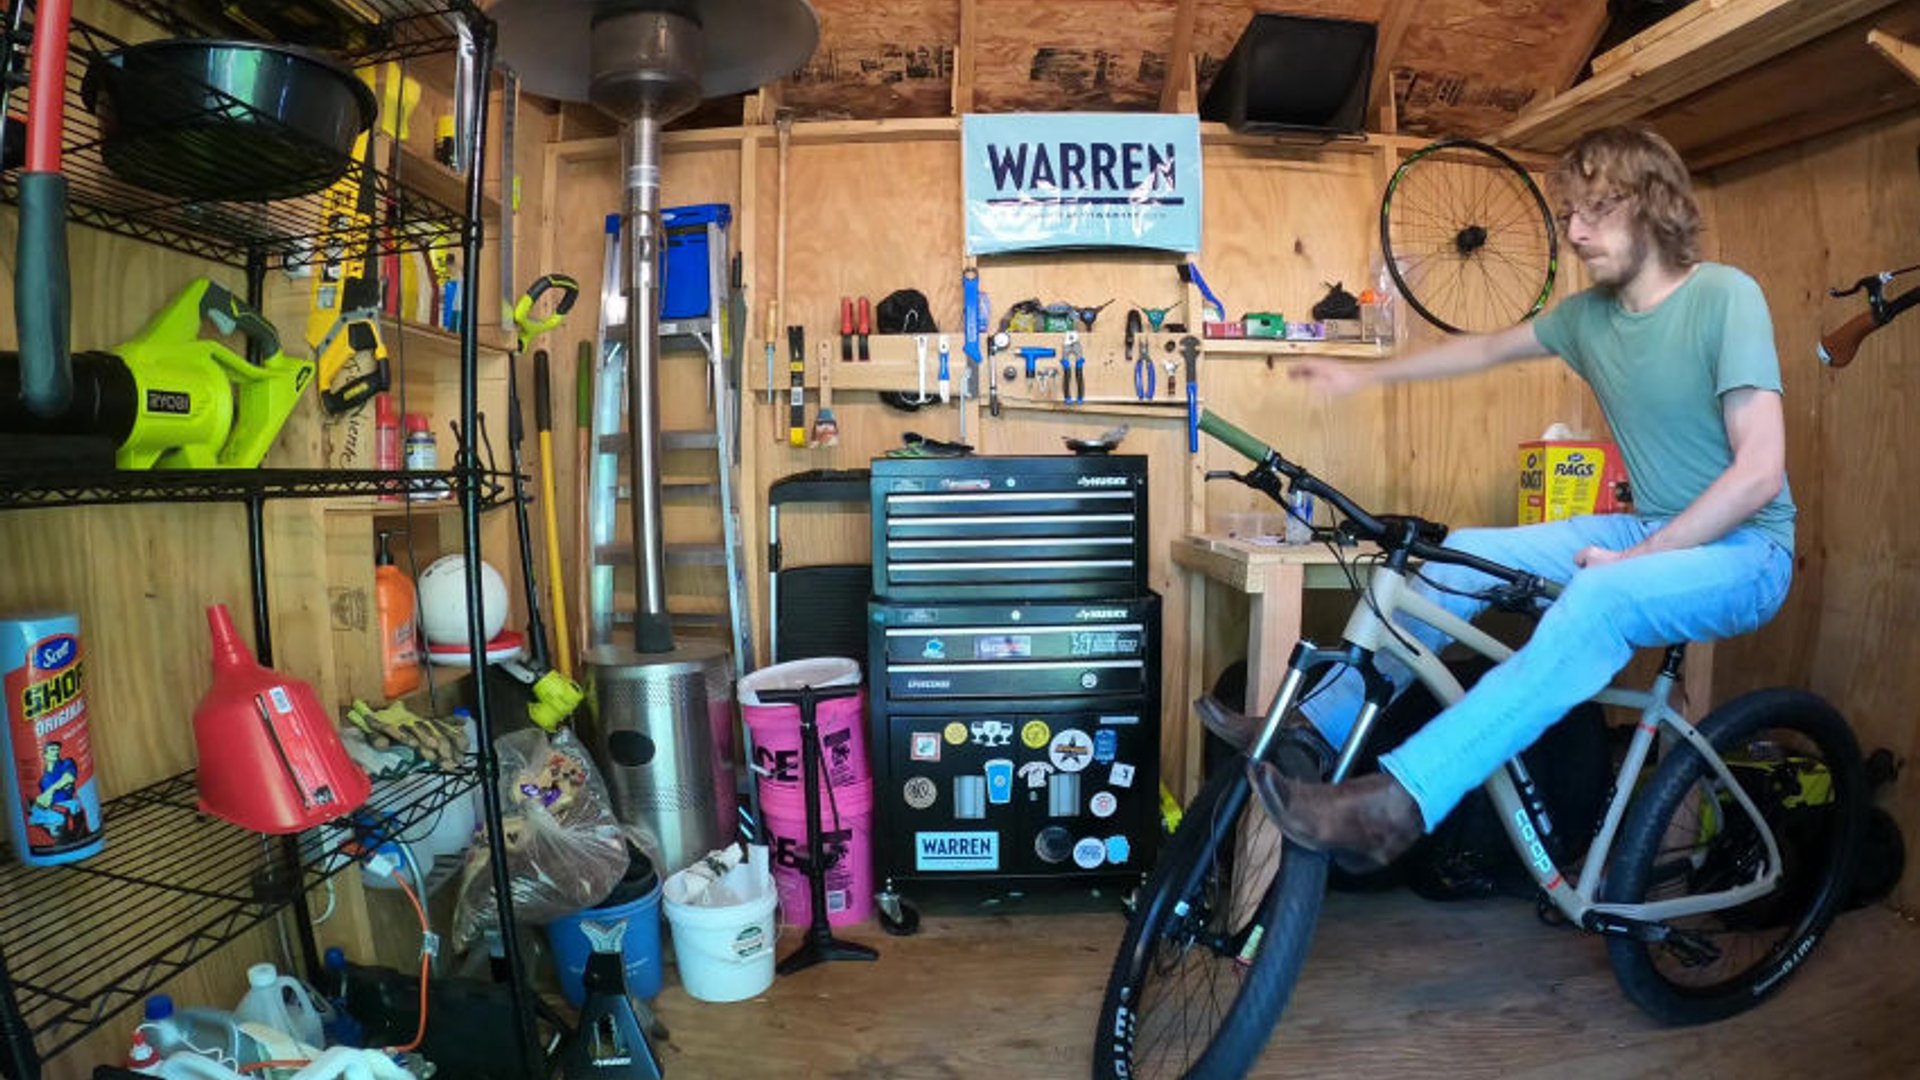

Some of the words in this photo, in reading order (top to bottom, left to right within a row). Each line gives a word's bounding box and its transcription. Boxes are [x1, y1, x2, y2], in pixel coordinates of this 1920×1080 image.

[986, 142, 1177, 191] WARREN
[1555, 463, 1595, 477] RAGS
[922, 838, 991, 855] WARREN
